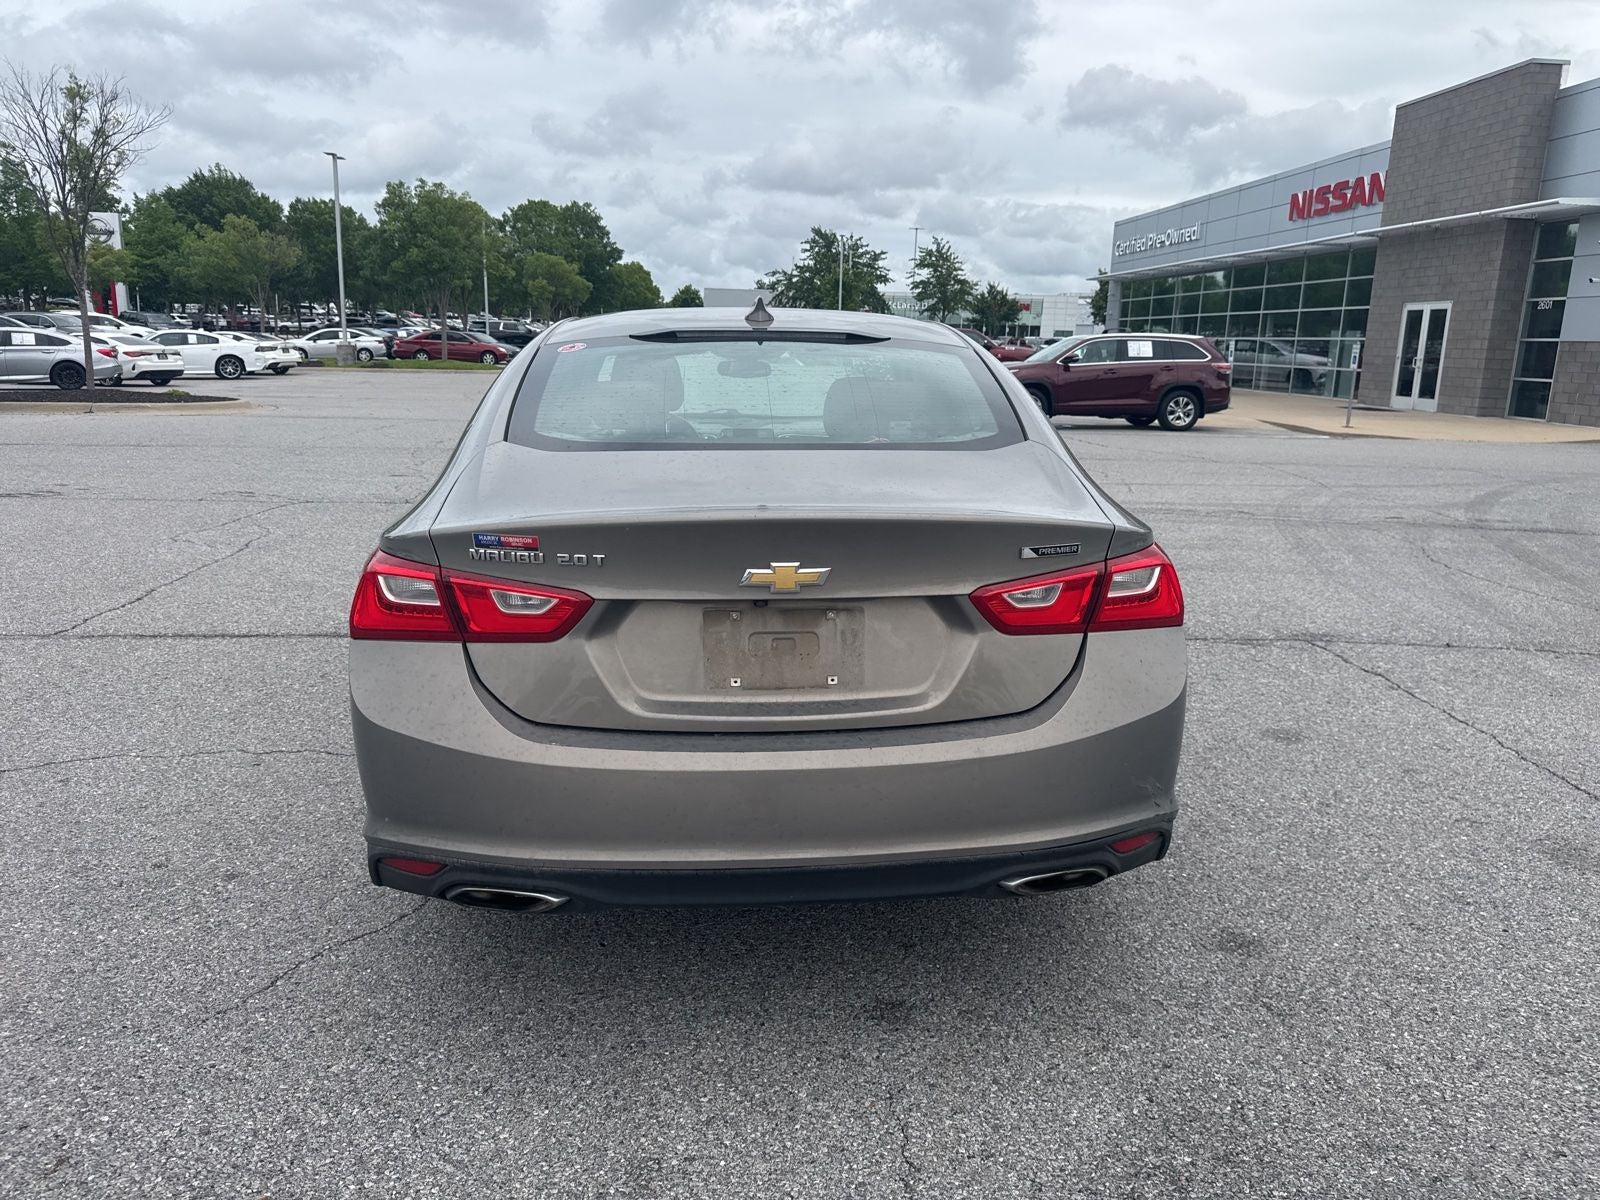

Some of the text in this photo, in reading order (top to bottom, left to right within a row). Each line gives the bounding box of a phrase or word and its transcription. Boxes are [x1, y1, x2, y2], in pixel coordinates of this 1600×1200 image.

[1288, 170, 1387, 222] NISSAN
[1114, 221, 1200, 256] Certified Pre-Owned
[1537, 300, 1553, 310] 2601
[469, 549, 544, 564] MALIBU
[1038, 546, 1078, 555] PREMIER
